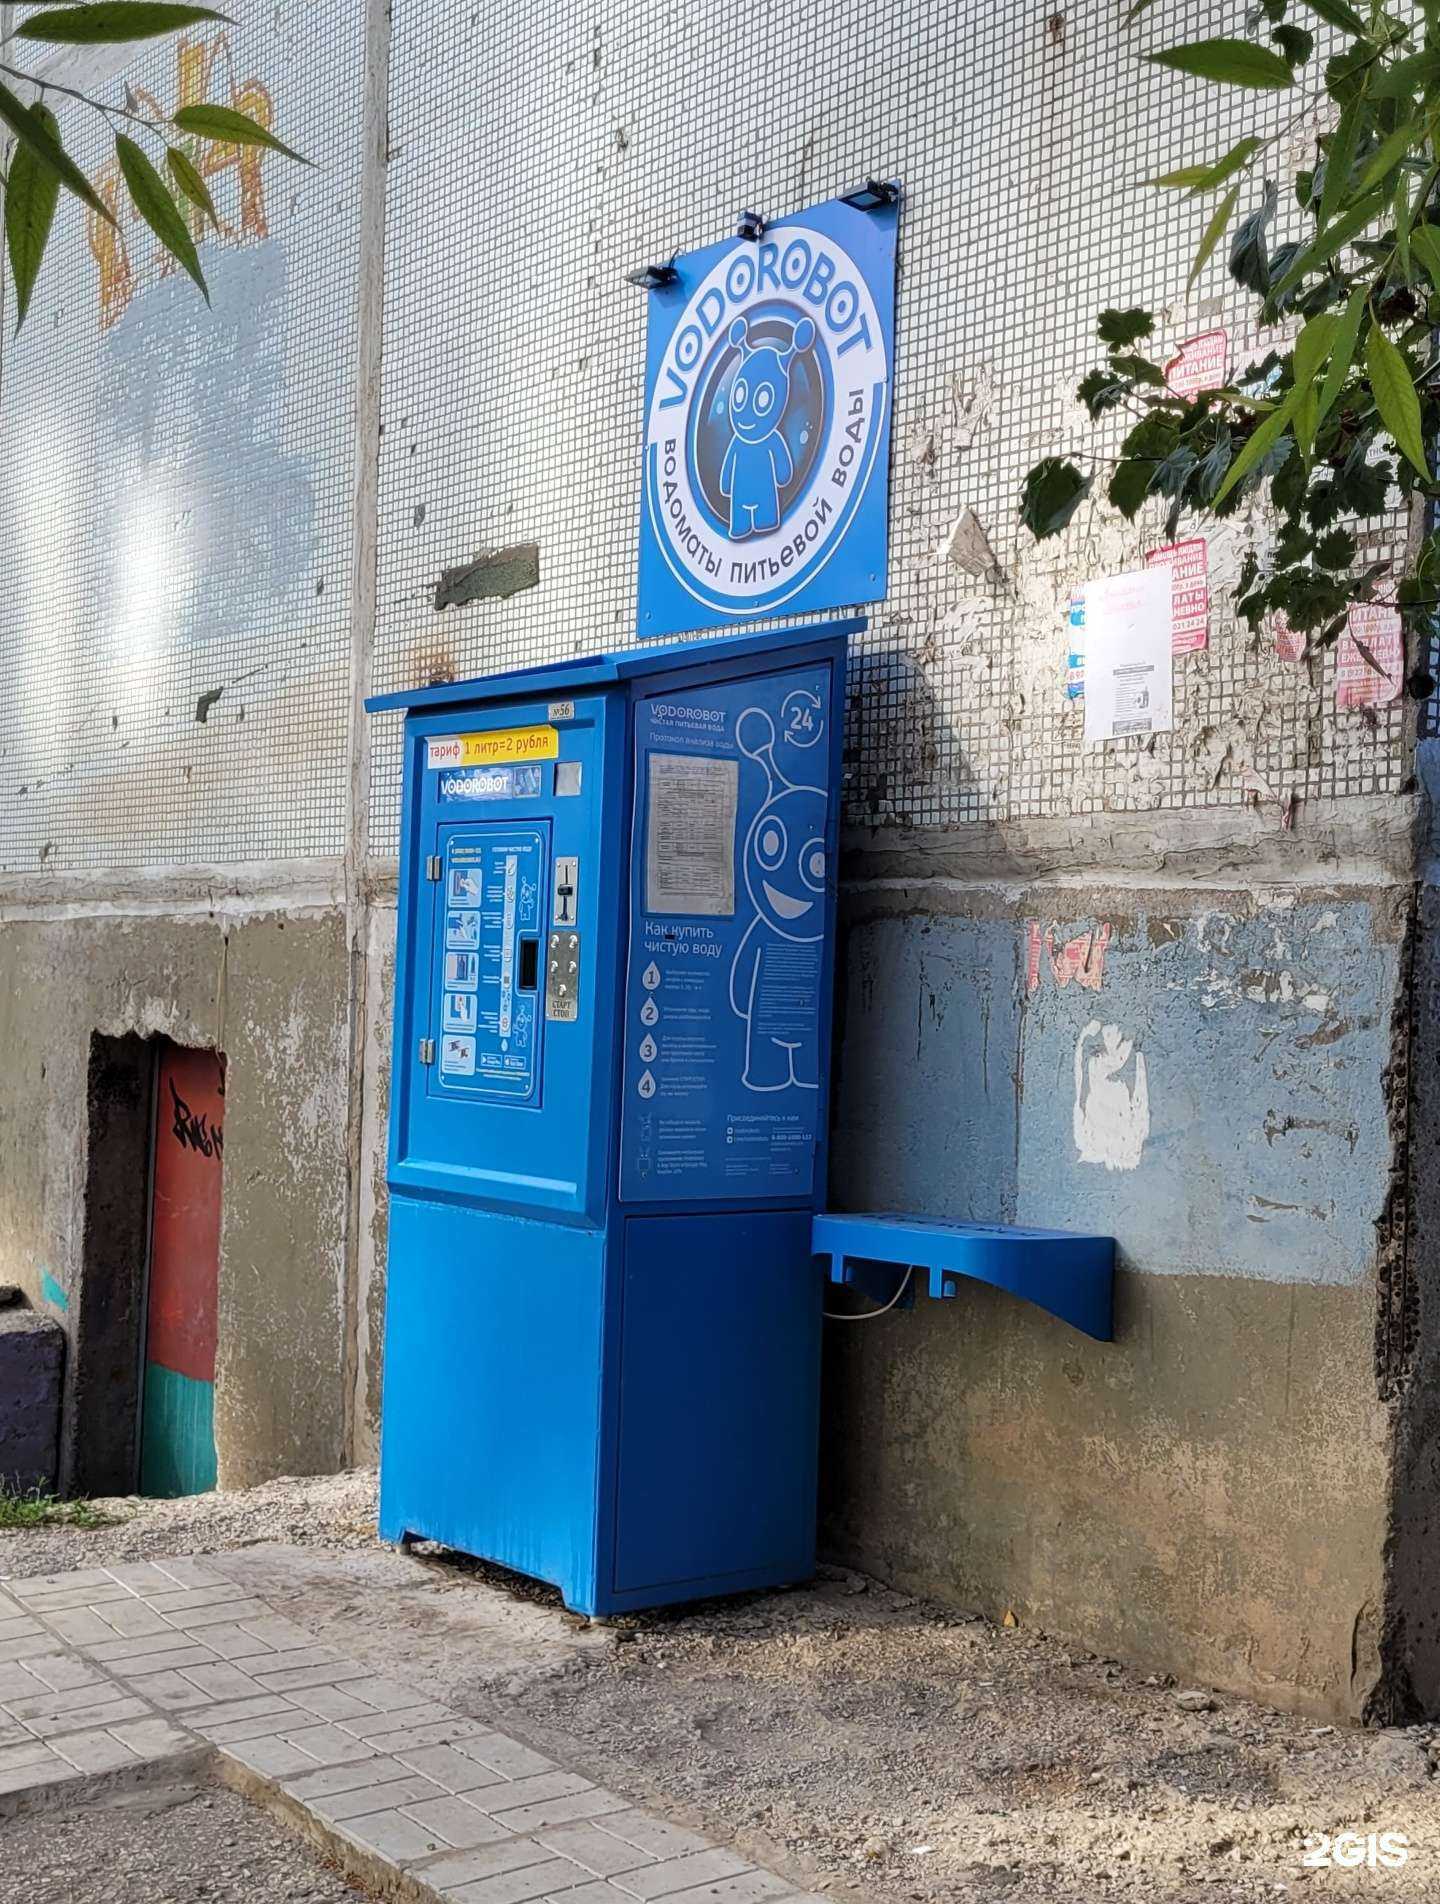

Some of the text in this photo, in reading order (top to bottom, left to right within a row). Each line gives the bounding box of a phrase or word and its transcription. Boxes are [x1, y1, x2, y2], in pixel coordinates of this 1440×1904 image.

[659, 238, 871, 411] VODOROBOT
[1172, 561, 1204, 579] АНИЕ
[1173, 589, 1204, 605] ЛАТЫ
[1173, 602, 1204, 617] НЕВНО
[651, 704, 726, 723] VODOROBOT
[790, 707, 813, 731] 24
[430, 743, 461, 760] тариф
[465, 742, 470, 755] 1
[516, 735, 549, 754] рубля
[441, 776, 509, 795] VODOROBOT
[645, 921, 714, 941] Как купить
[644, 940, 722, 958] чистую воду
[648, 971, 655, 984] 1
[646, 1007, 654, 1020] 2
[644, 1044, 652, 1057] 3
[642, 1080, 651, 1093] 4
